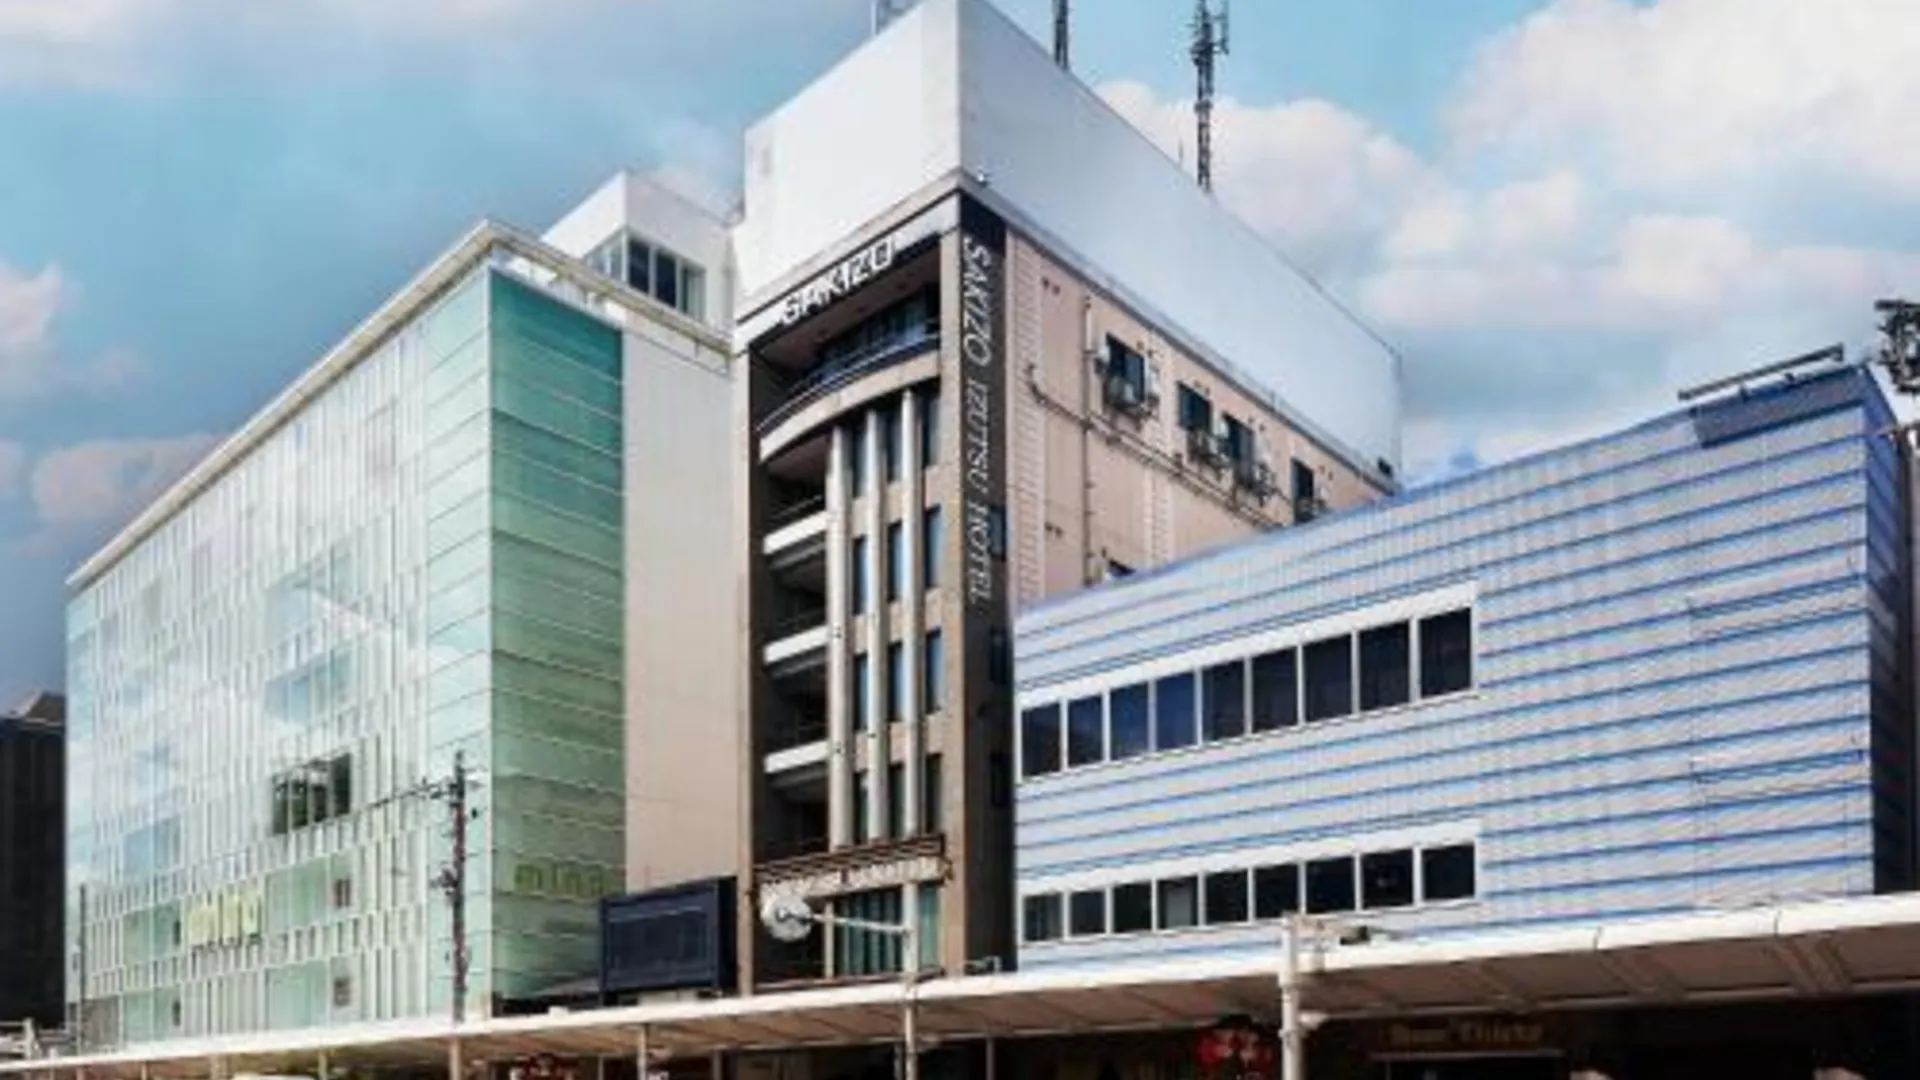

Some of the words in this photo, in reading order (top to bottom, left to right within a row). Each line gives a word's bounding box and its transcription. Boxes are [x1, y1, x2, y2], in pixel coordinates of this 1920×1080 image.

[780, 236, 894, 326] SAKIZO
[962, 236, 992, 367] SAKIZO
[966, 377, 990, 495] IZUTSU
[966, 499, 992, 605] HOTEL
